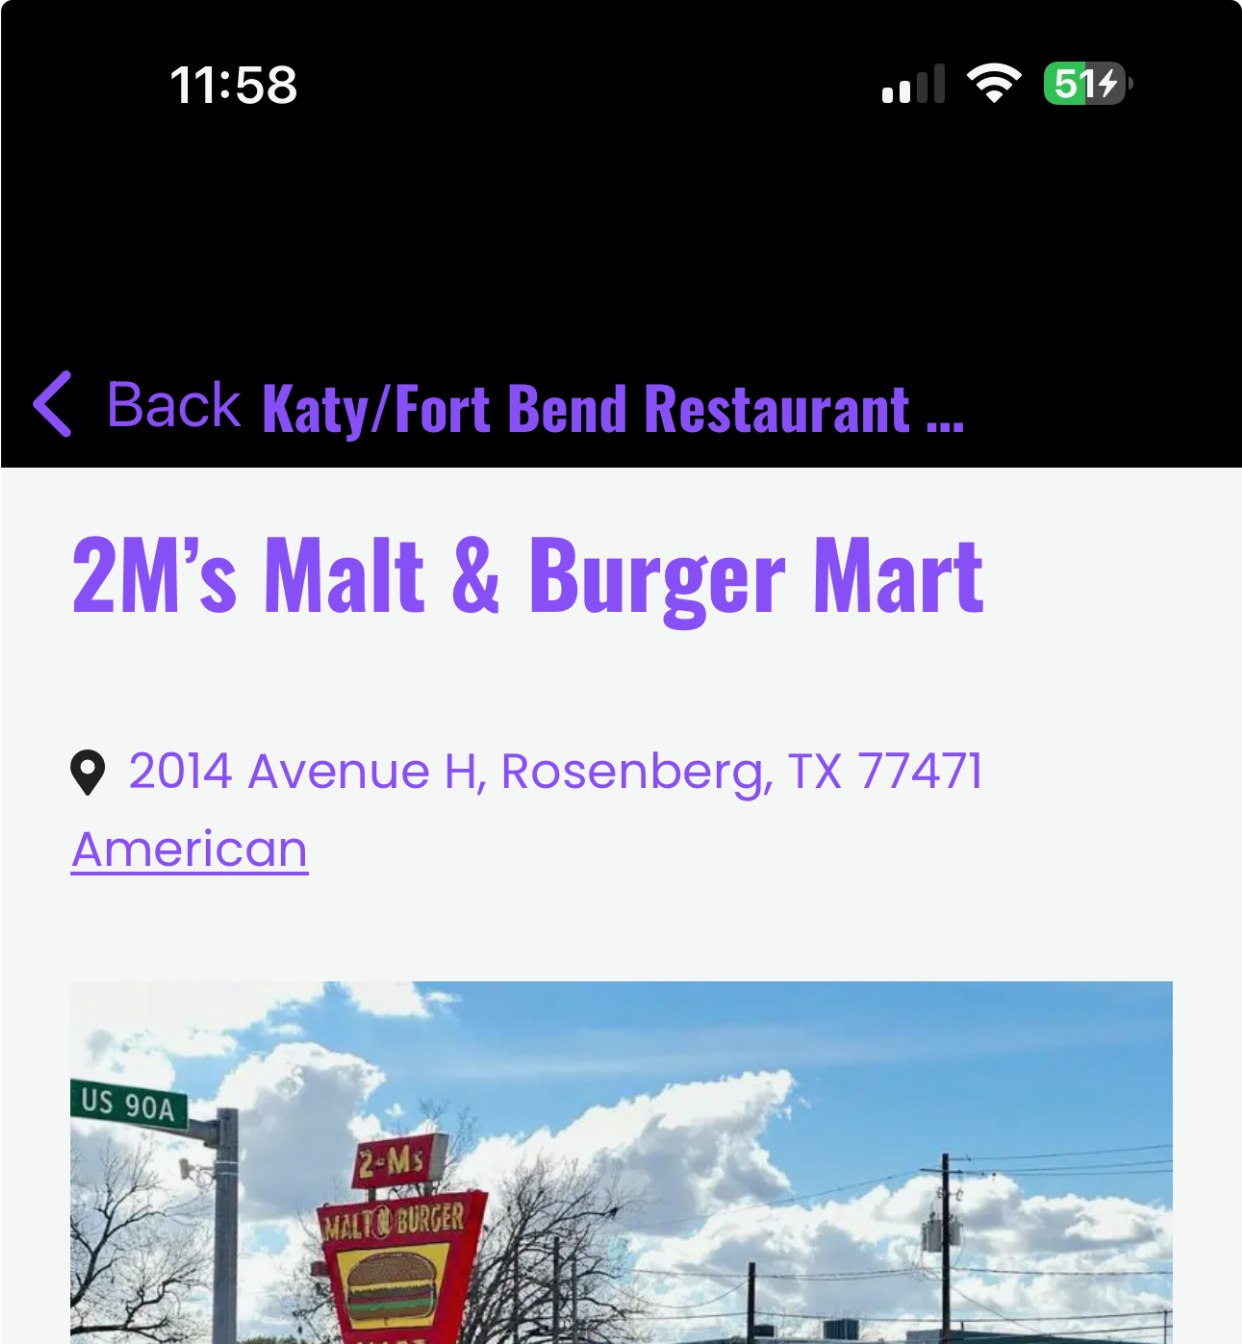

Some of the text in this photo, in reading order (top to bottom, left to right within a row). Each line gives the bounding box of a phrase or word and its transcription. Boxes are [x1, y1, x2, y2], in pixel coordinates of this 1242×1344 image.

[171, 65, 297, 104] 11:58
[1055, 68, 1094, 99] 51
[110, 380, 242, 427] Back
[264, 384, 490, 442] Katy/Fort
[509, 384, 626, 433] Bend
[646, 384, 910, 433] Restaurant
[74, 536, 983, 630] 2M’s Malt & Burger Mart
[130, 751, 979, 801] 2014 Avenue H, Rosenberg, TX 77471
[70, 828, 309, 871] American
[82, 1087, 175, 1122] US 90A
[322, 1210, 372, 1241] MALT
[397, 1201, 464, 1235] BURGER
